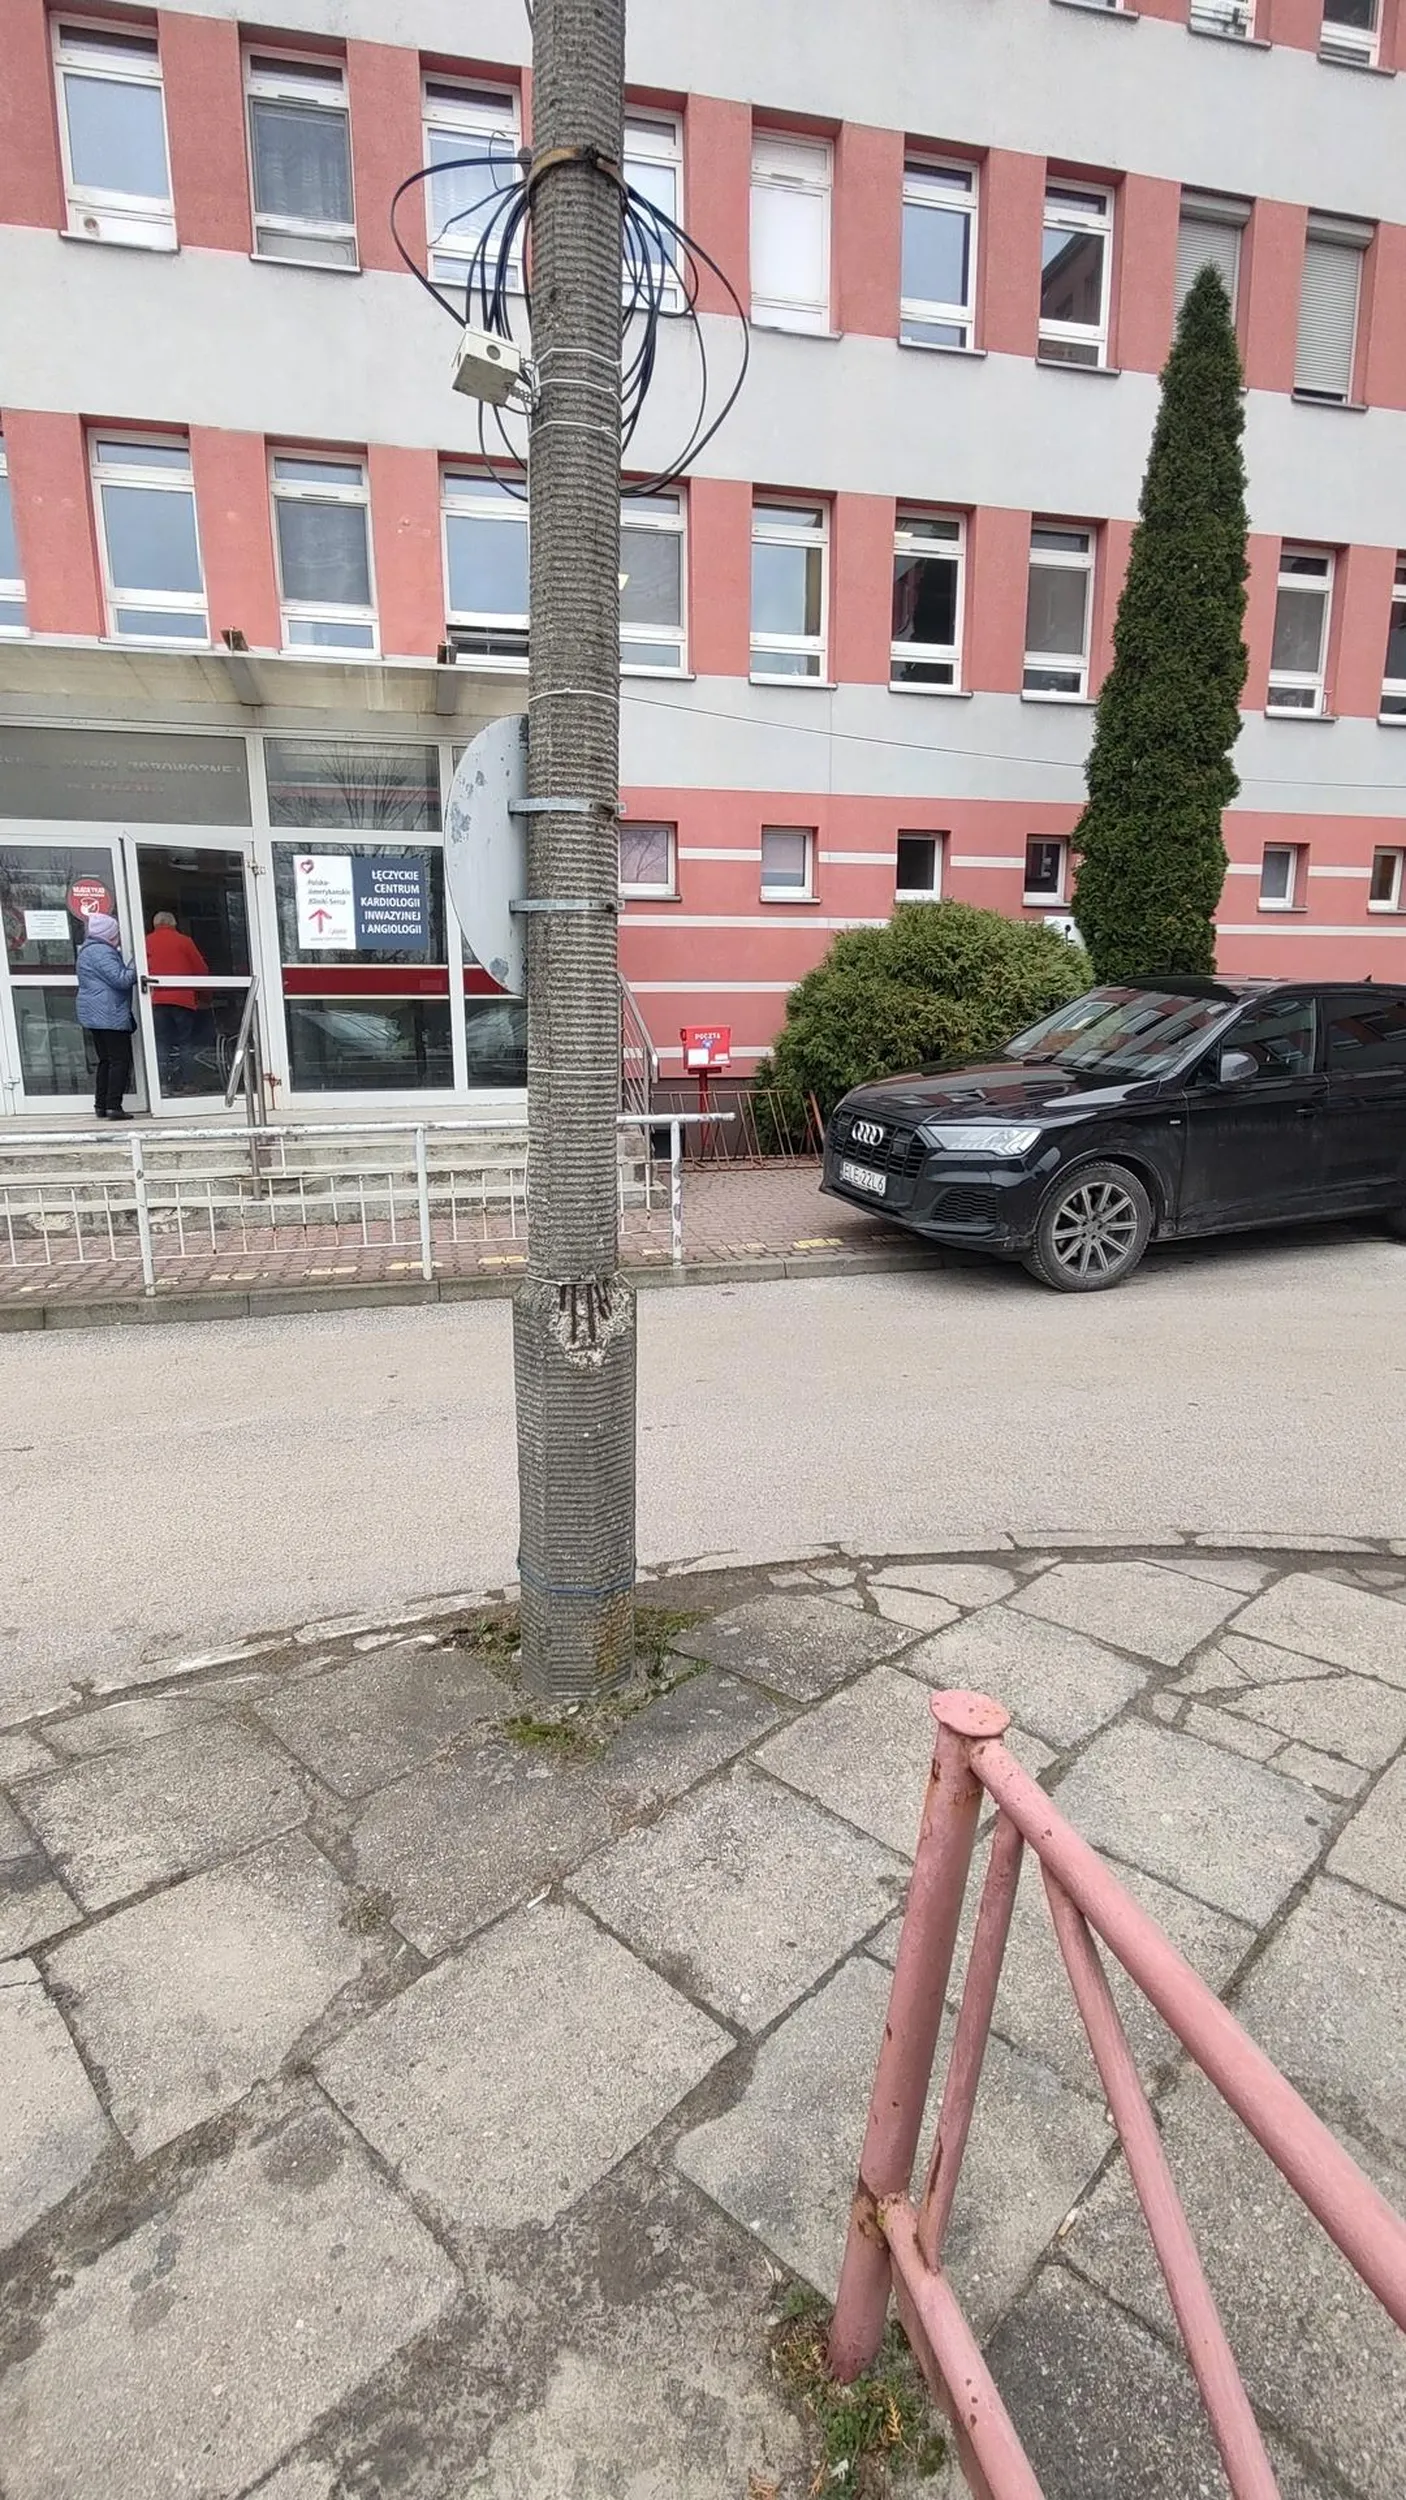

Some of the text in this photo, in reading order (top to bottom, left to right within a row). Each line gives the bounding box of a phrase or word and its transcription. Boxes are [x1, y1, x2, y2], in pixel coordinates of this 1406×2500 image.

[372, 870, 419, 882] ŁĘCZYCKIE
[374, 883, 420, 894] CENTRUM
[360, 897, 420, 908] KARDIOLOGII
[364, 911, 421, 921] INWAZYJNEJ
[361, 924, 422, 935] I ANGIOLOGII
